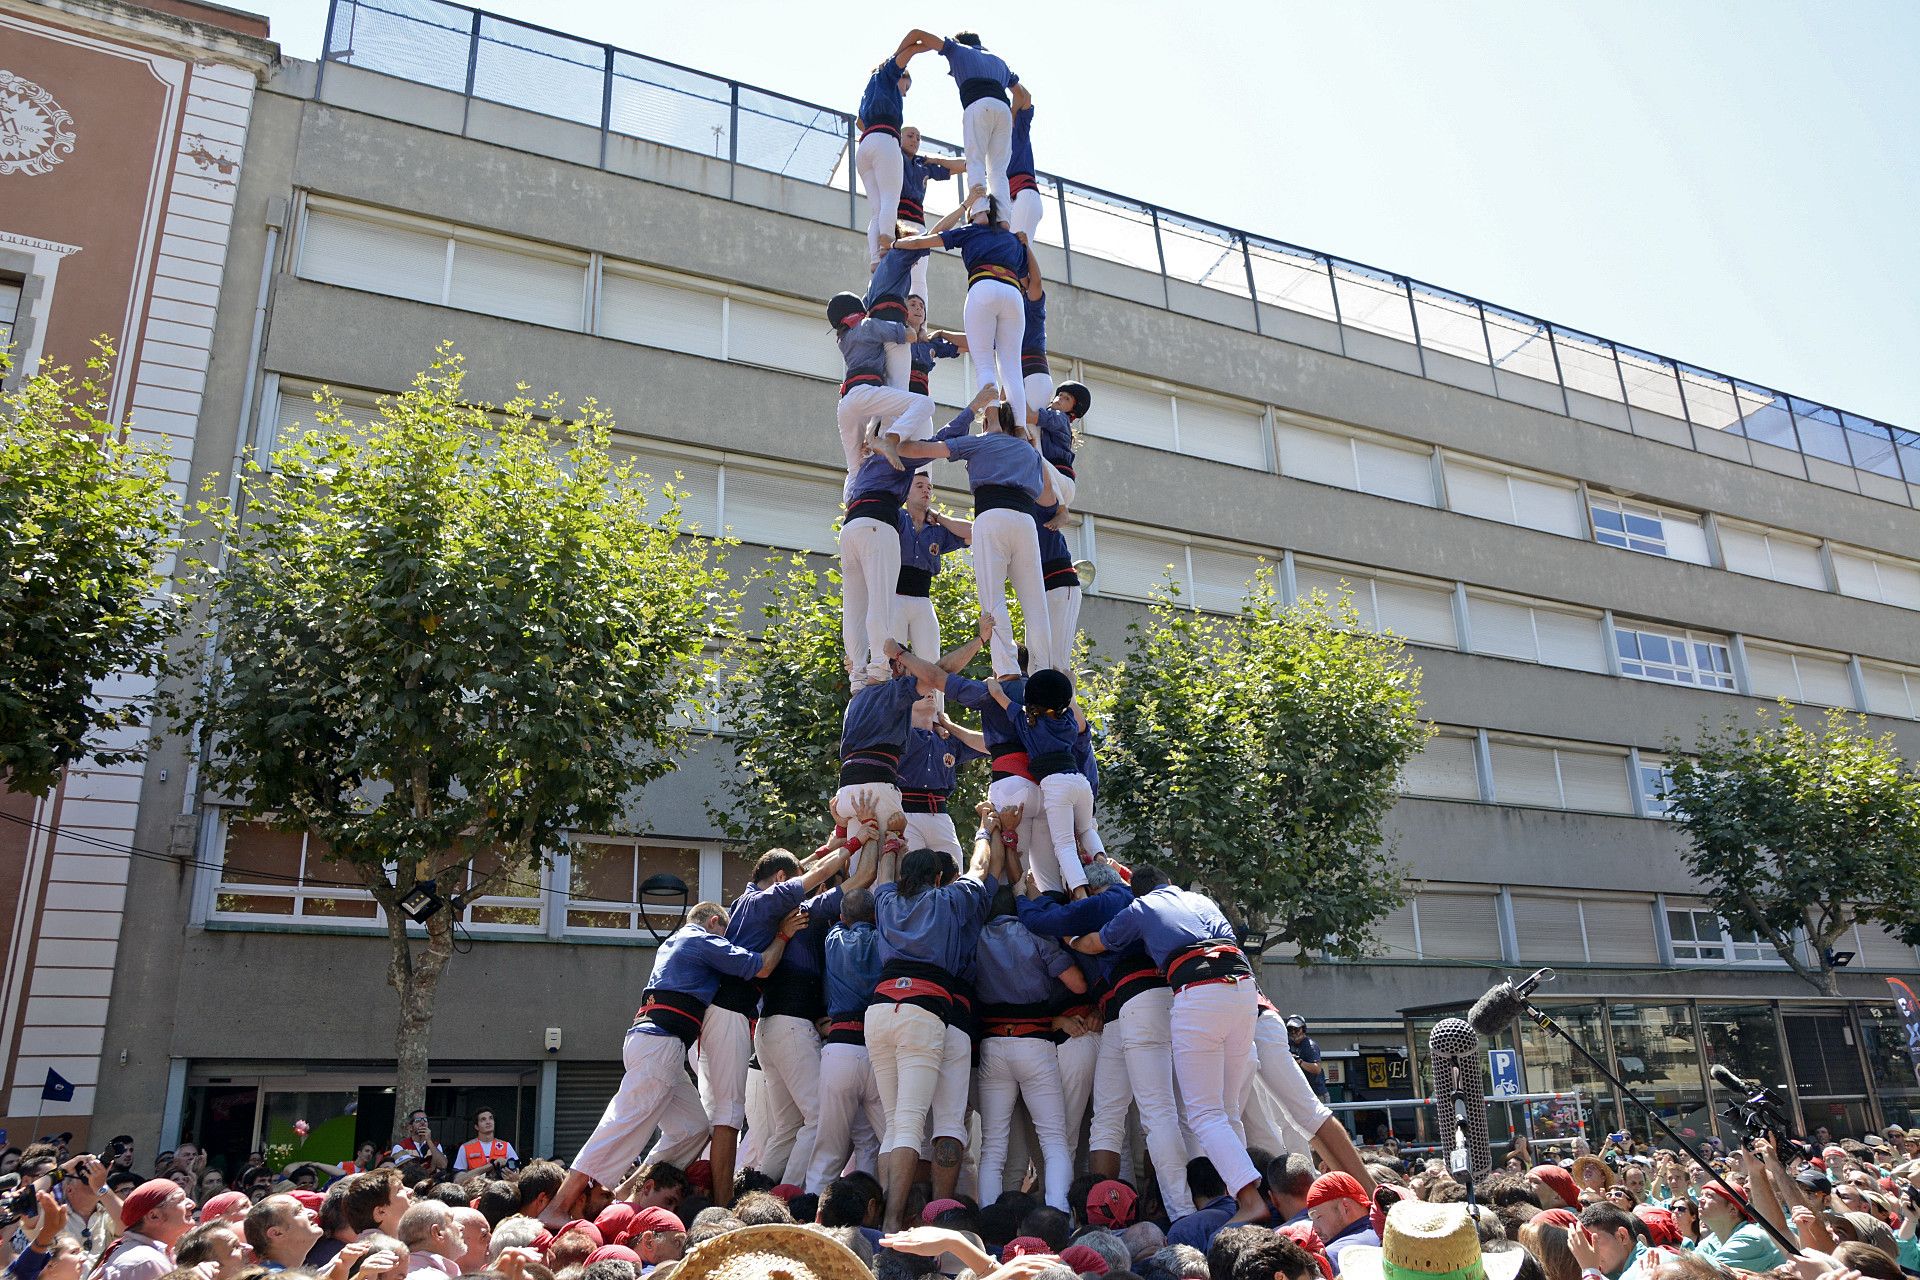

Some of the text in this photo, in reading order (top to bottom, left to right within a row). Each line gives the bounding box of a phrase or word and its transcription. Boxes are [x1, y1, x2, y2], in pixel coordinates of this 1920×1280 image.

[20, 124, 40, 134] 1962
[1388, 1058, 1409, 1079] El
[1496, 1053, 1510, 1075] P
